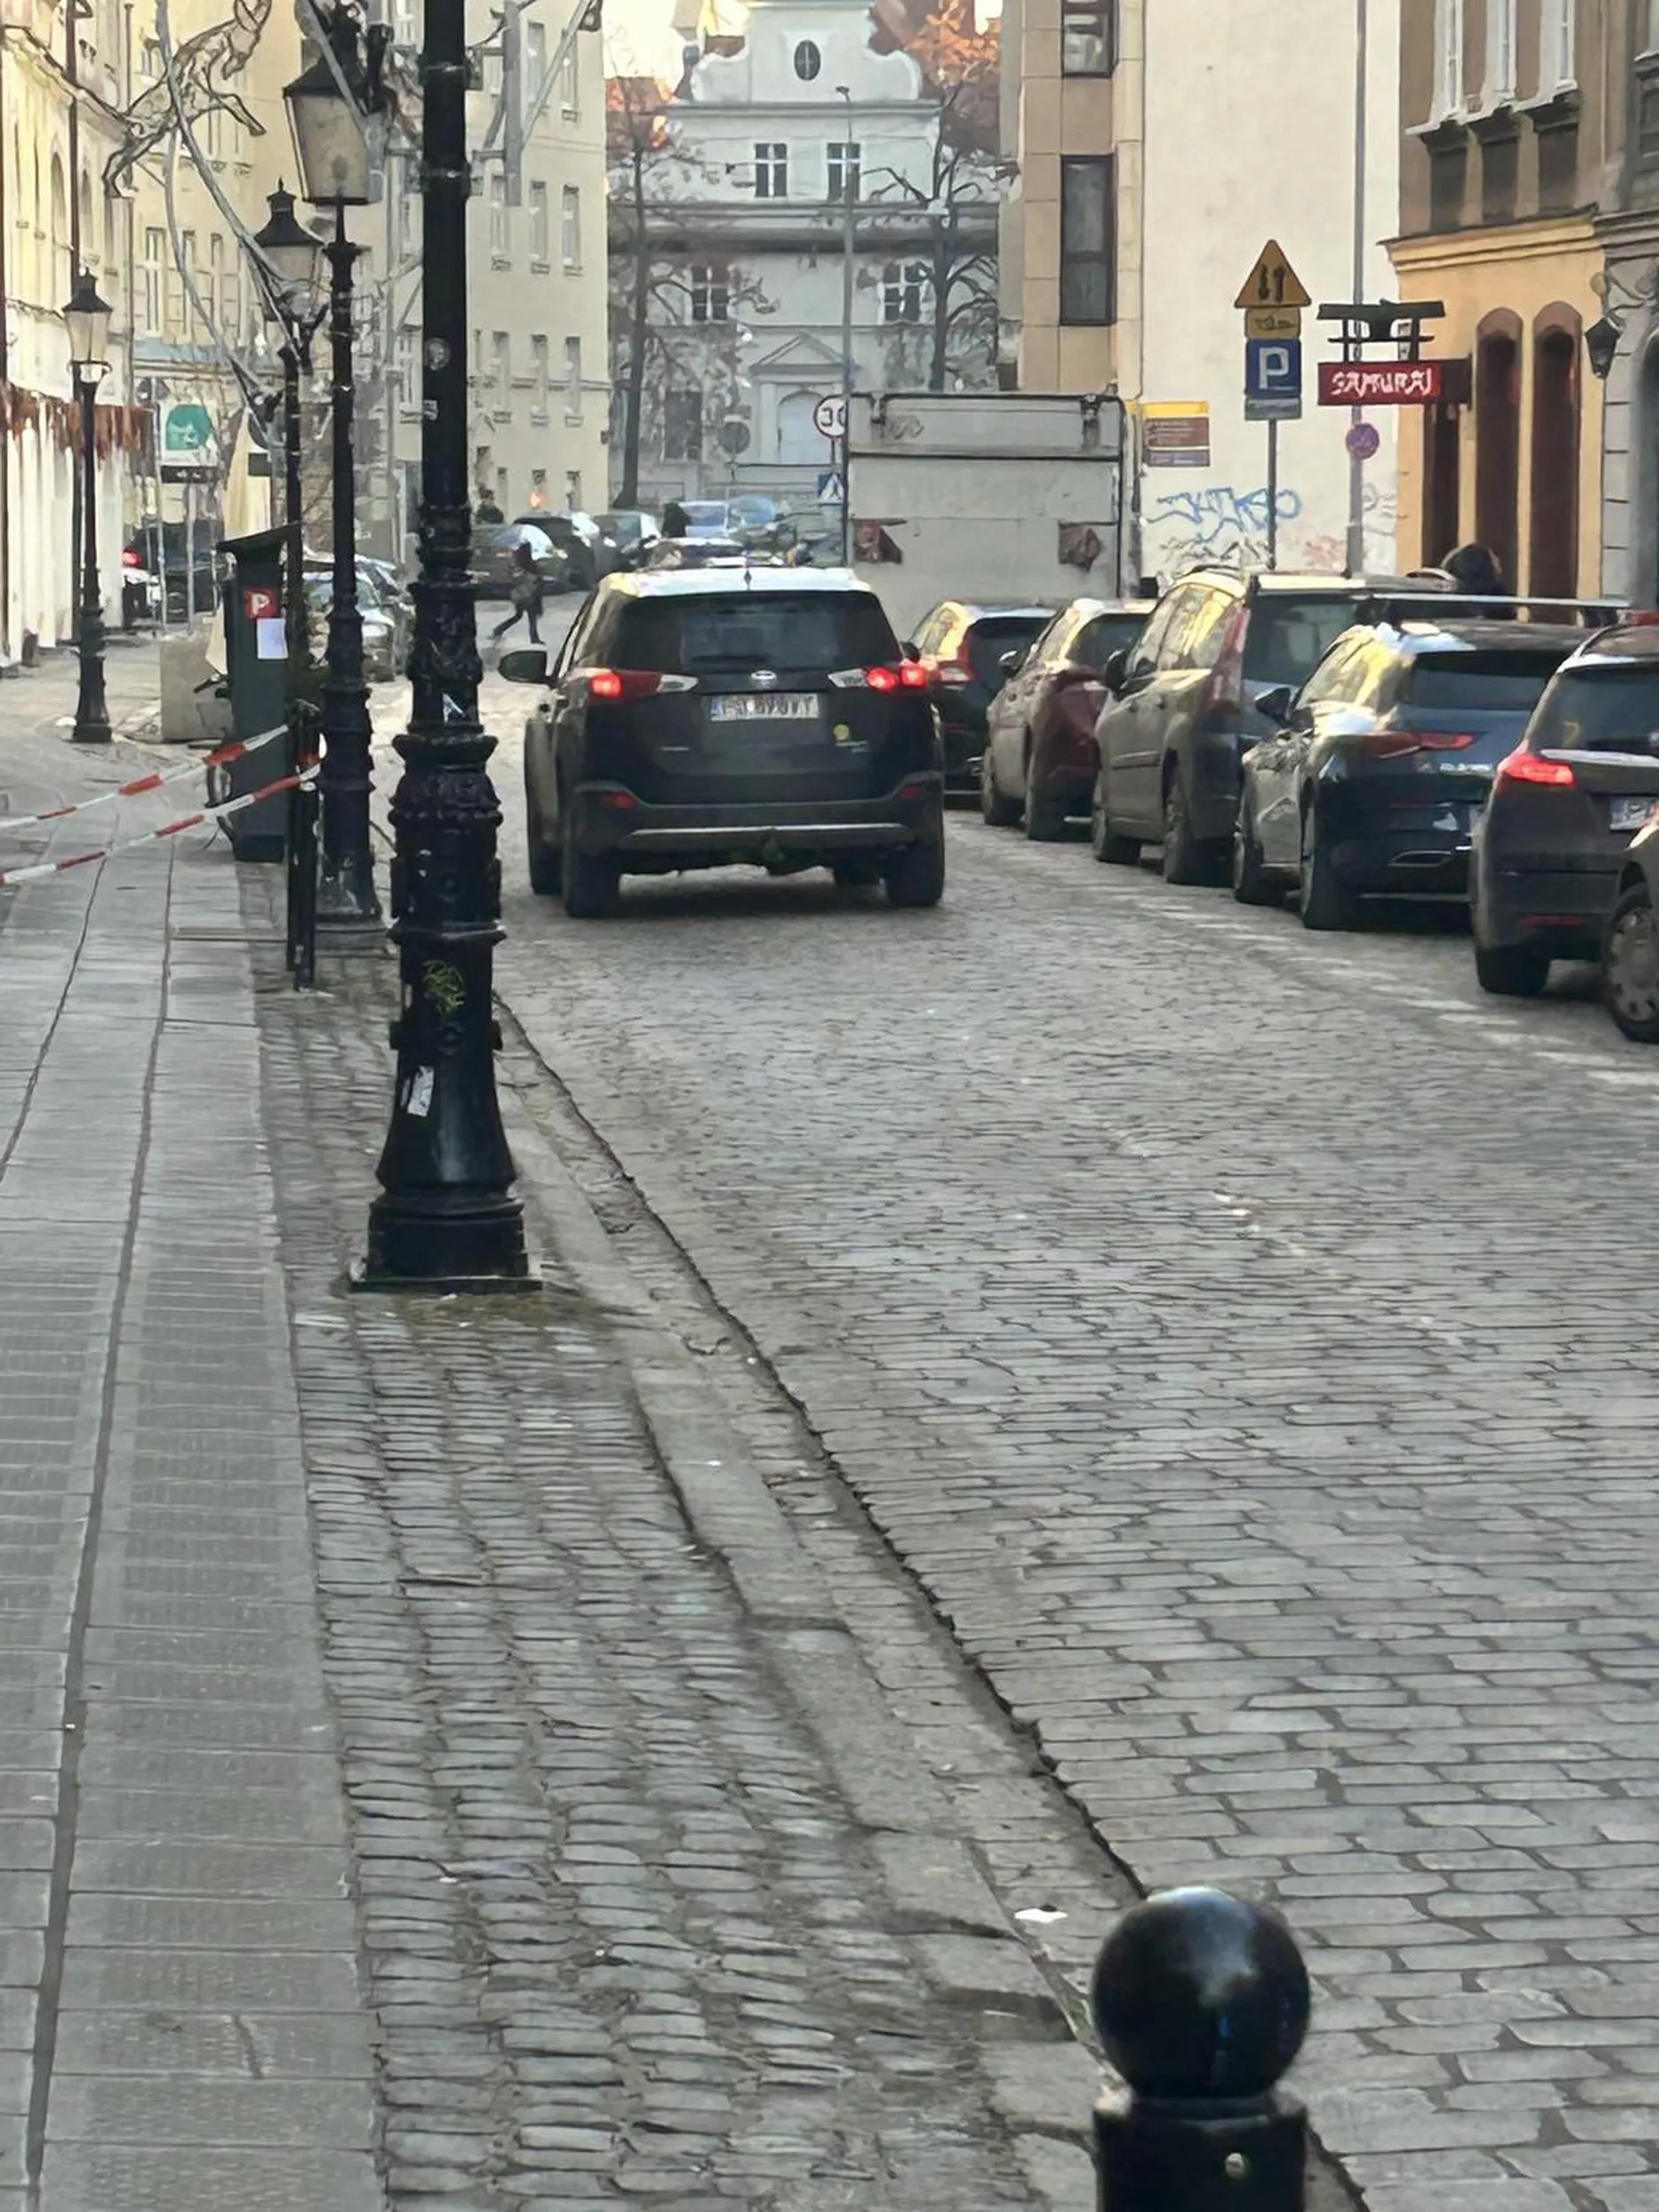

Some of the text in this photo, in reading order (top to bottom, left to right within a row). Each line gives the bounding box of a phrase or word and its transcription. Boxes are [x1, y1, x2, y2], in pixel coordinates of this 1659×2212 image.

[1258, 346, 1289, 389] P
[1331, 368, 1432, 397] SAMURAI
[250, 592, 271, 617] P
